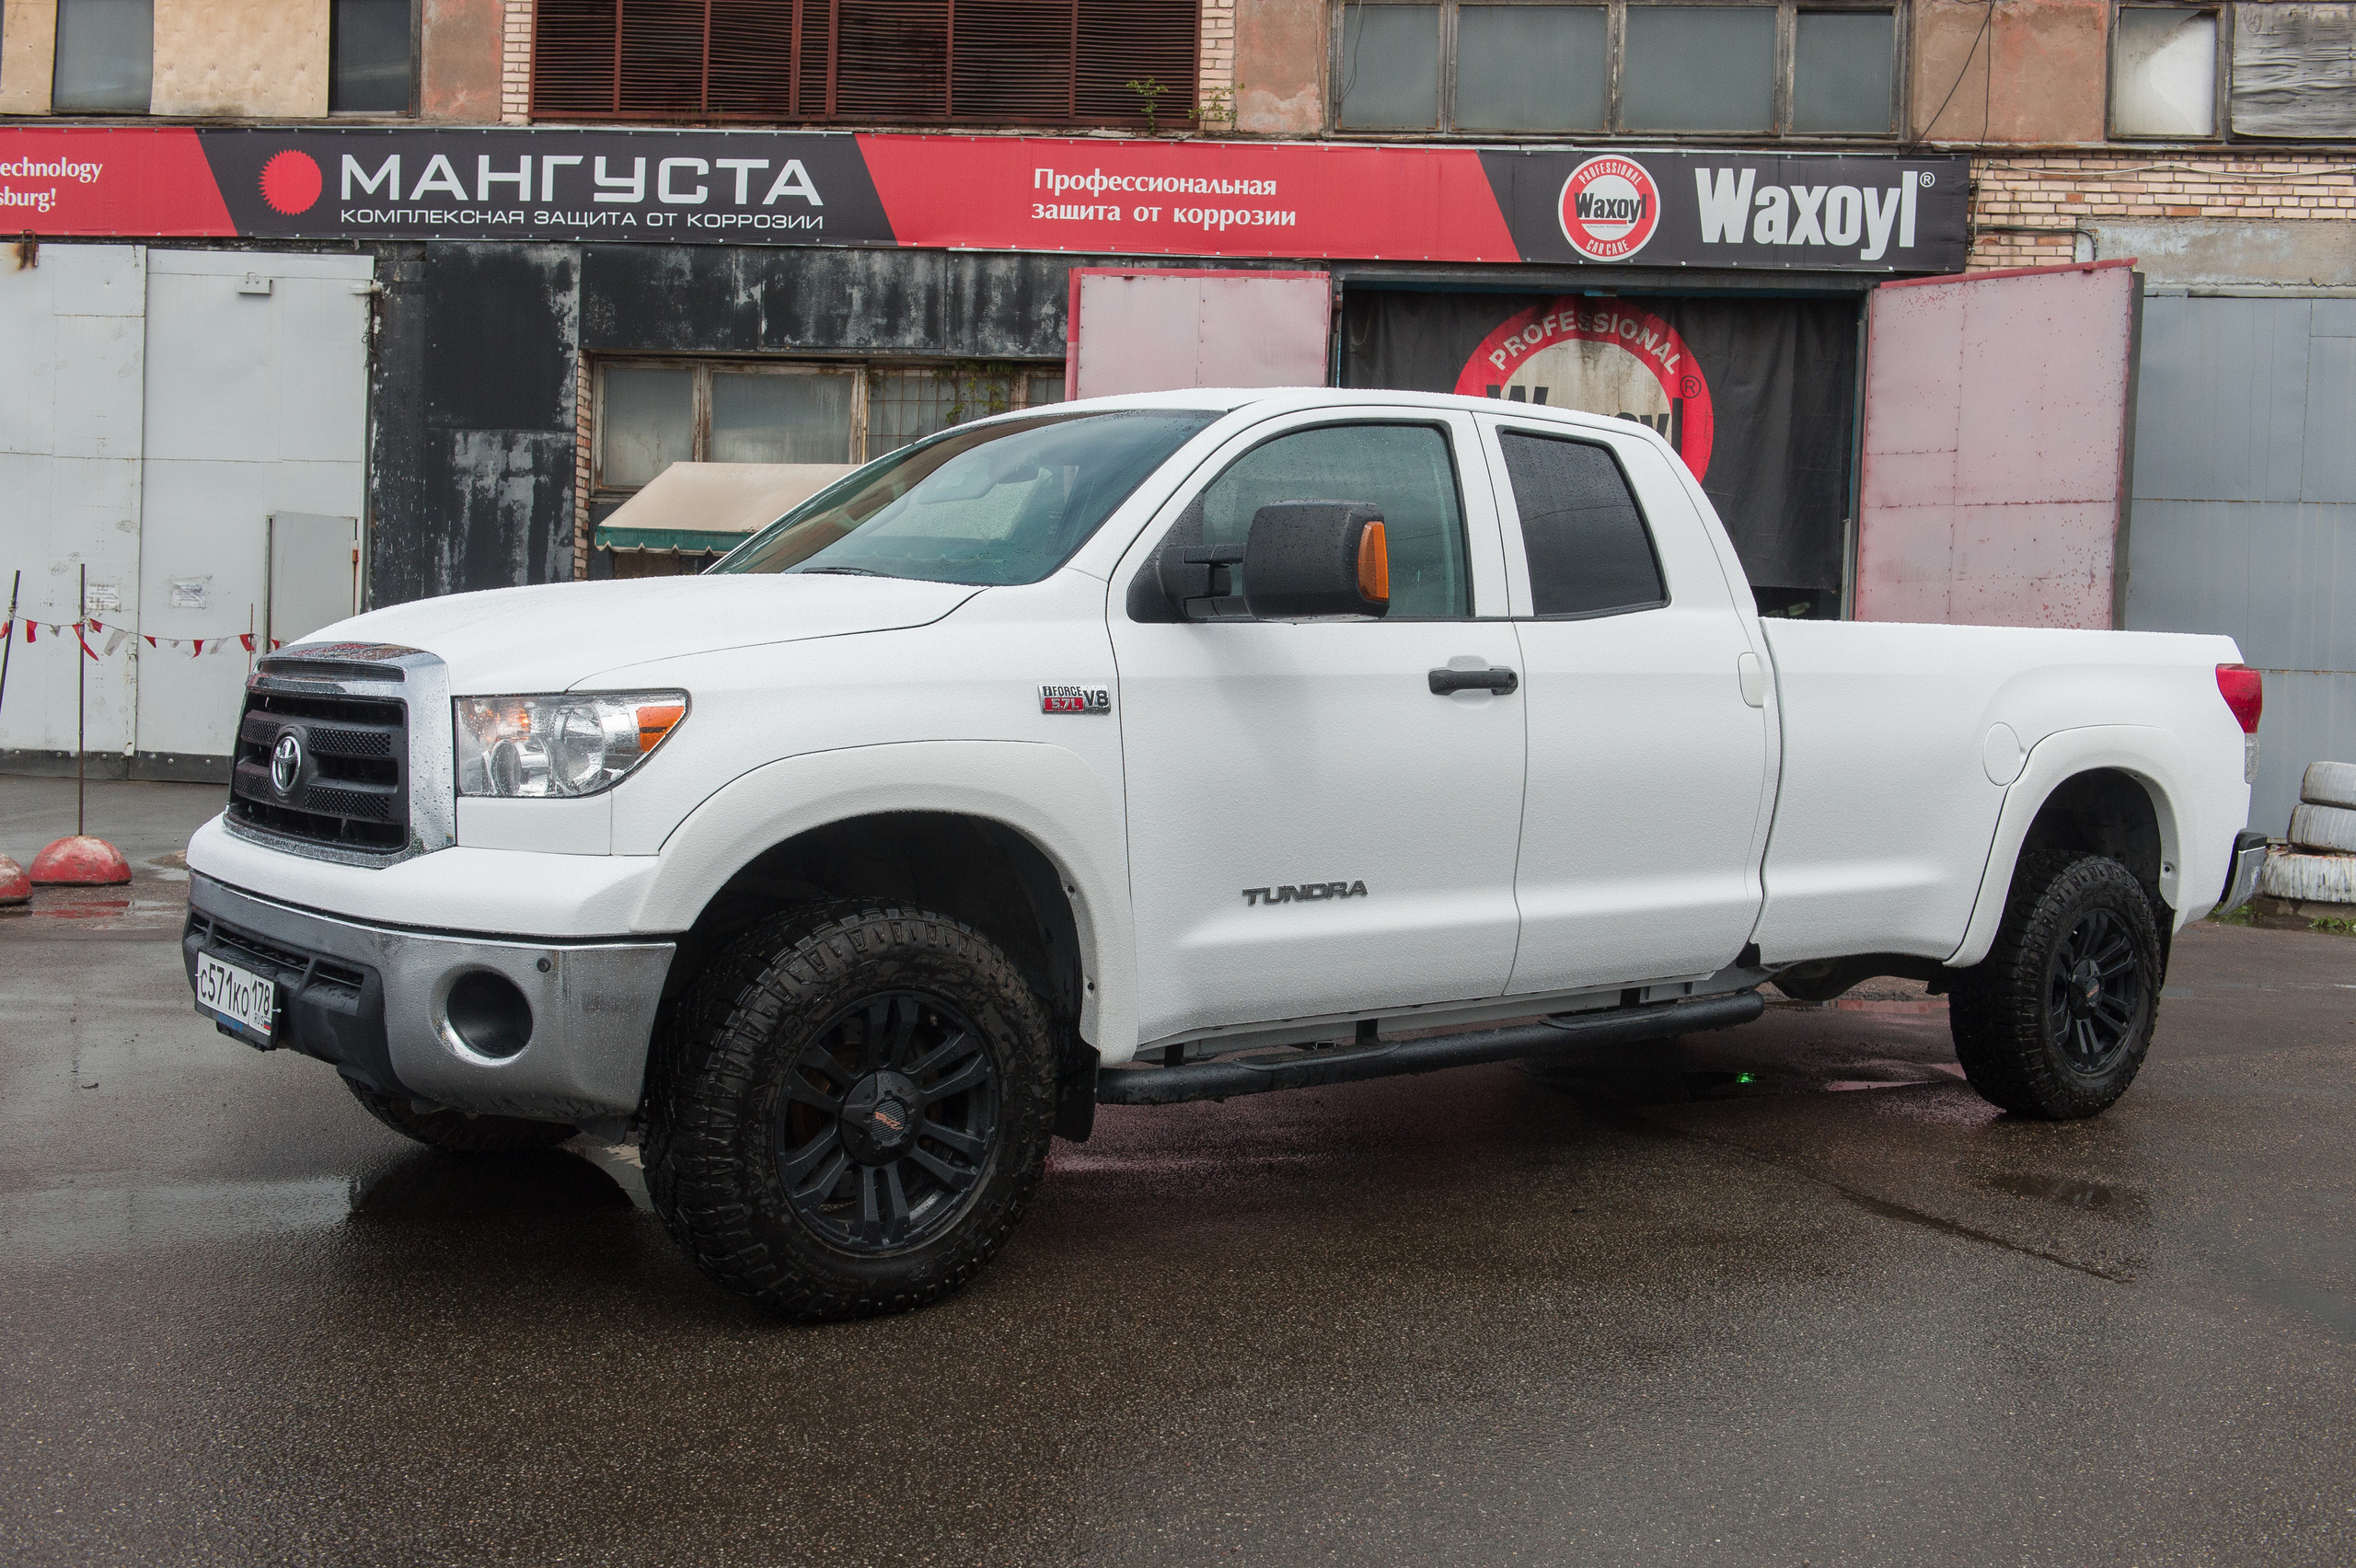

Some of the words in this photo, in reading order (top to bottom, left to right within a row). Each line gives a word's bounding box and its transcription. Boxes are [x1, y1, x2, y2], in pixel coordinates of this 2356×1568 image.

[0, 156, 102, 182] echnology
[341, 154, 824, 206] МАНГУСТА
[1577, 162, 1643, 185] PROFESSIONAL
[1034, 168, 1276, 197] Профессиональная
[341, 209, 525, 225] КОМПЛЕКСНАЯ
[534, 211, 637, 229] ЗАЩИТА
[647, 213, 678, 227] ОТ
[687, 213, 824, 230] КОРРОЗИИ
[1032, 202, 1121, 223] защита
[1133, 206, 1161, 223] от
[1173, 205, 1296, 231] коррозии
[1586, 239, 1604, 255] CAR
[1606, 239, 1630, 255] CARE
[1488, 310, 1680, 375] PROFESSIONAL
[1051, 698, 1080, 709] 5.7L
[1083, 690, 1110, 707] V8
[1242, 880, 1369, 907] TUNDRA
[252, 979, 271, 1016] 178
[254, 1012, 264, 1027] RUS
